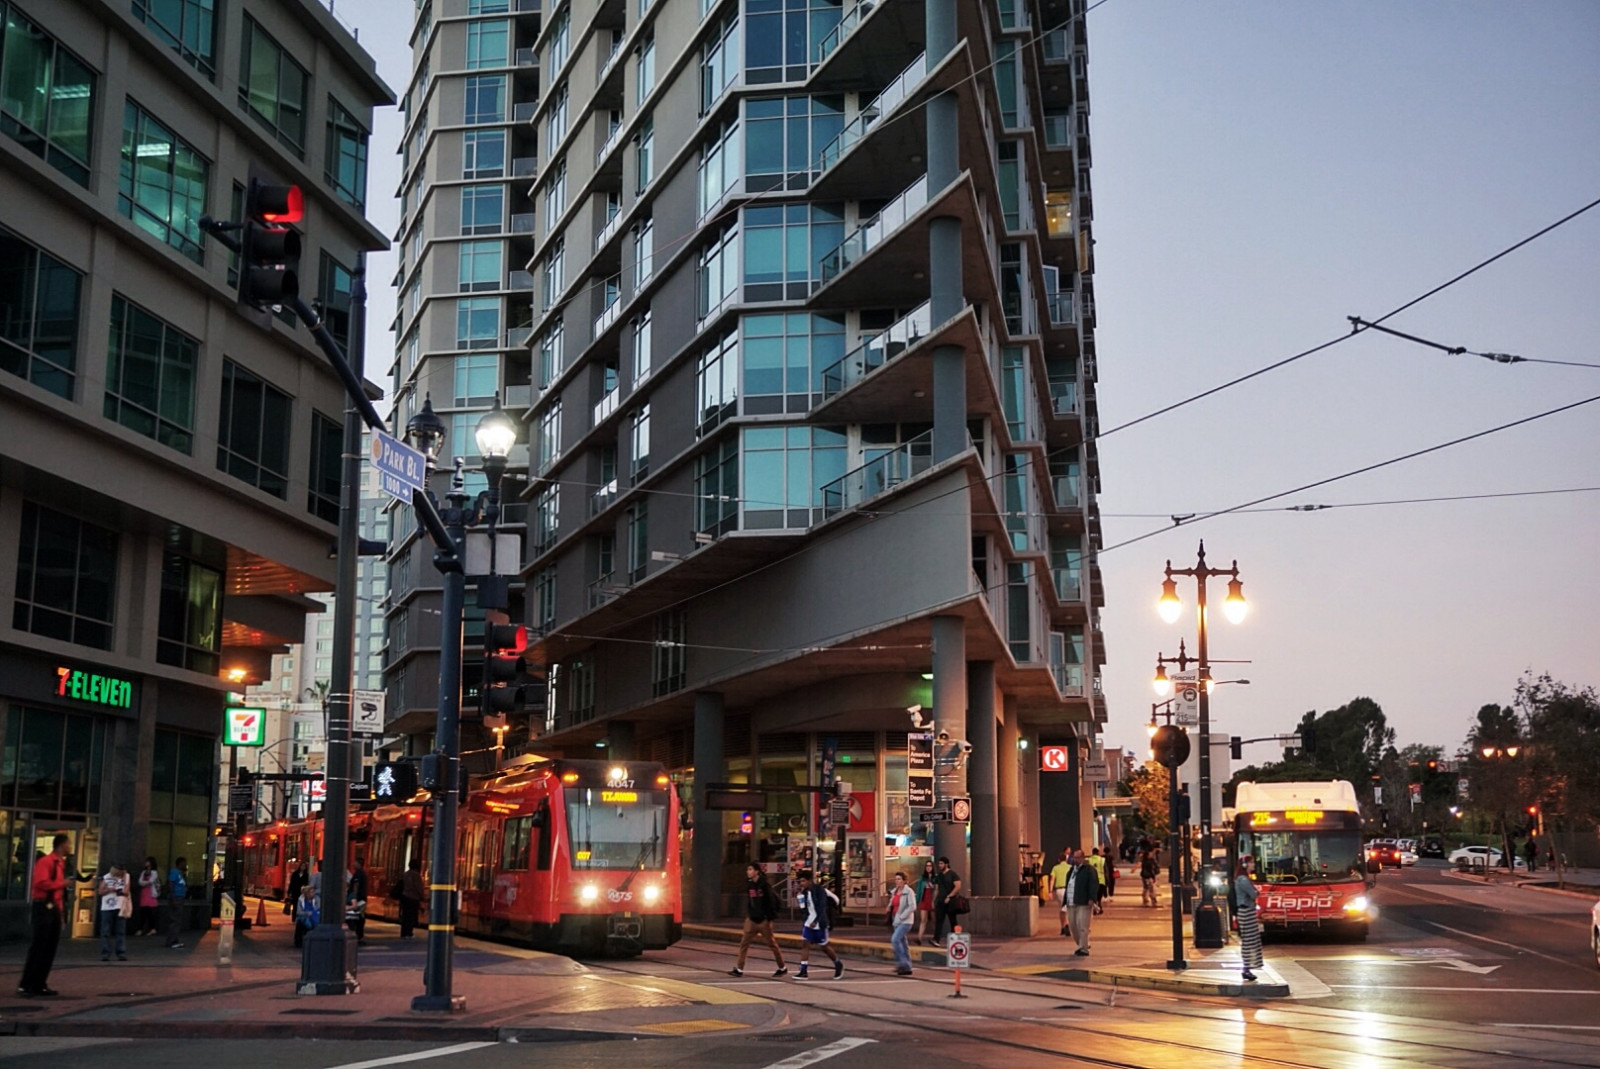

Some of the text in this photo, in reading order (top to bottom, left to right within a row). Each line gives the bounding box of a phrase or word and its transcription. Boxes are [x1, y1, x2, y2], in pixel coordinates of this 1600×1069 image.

[383, 442, 420, 481] PARK BL.
[385, 475, 400, 495] 1000
[1175, 703, 1181, 711] 7
[1175, 713, 1189, 722] 215
[235, 713, 256, 742] 7
[607, 780, 635, 788] 4047
[1253, 812, 1271, 826] 215
[1266, 895, 1333, 910] Rapid
